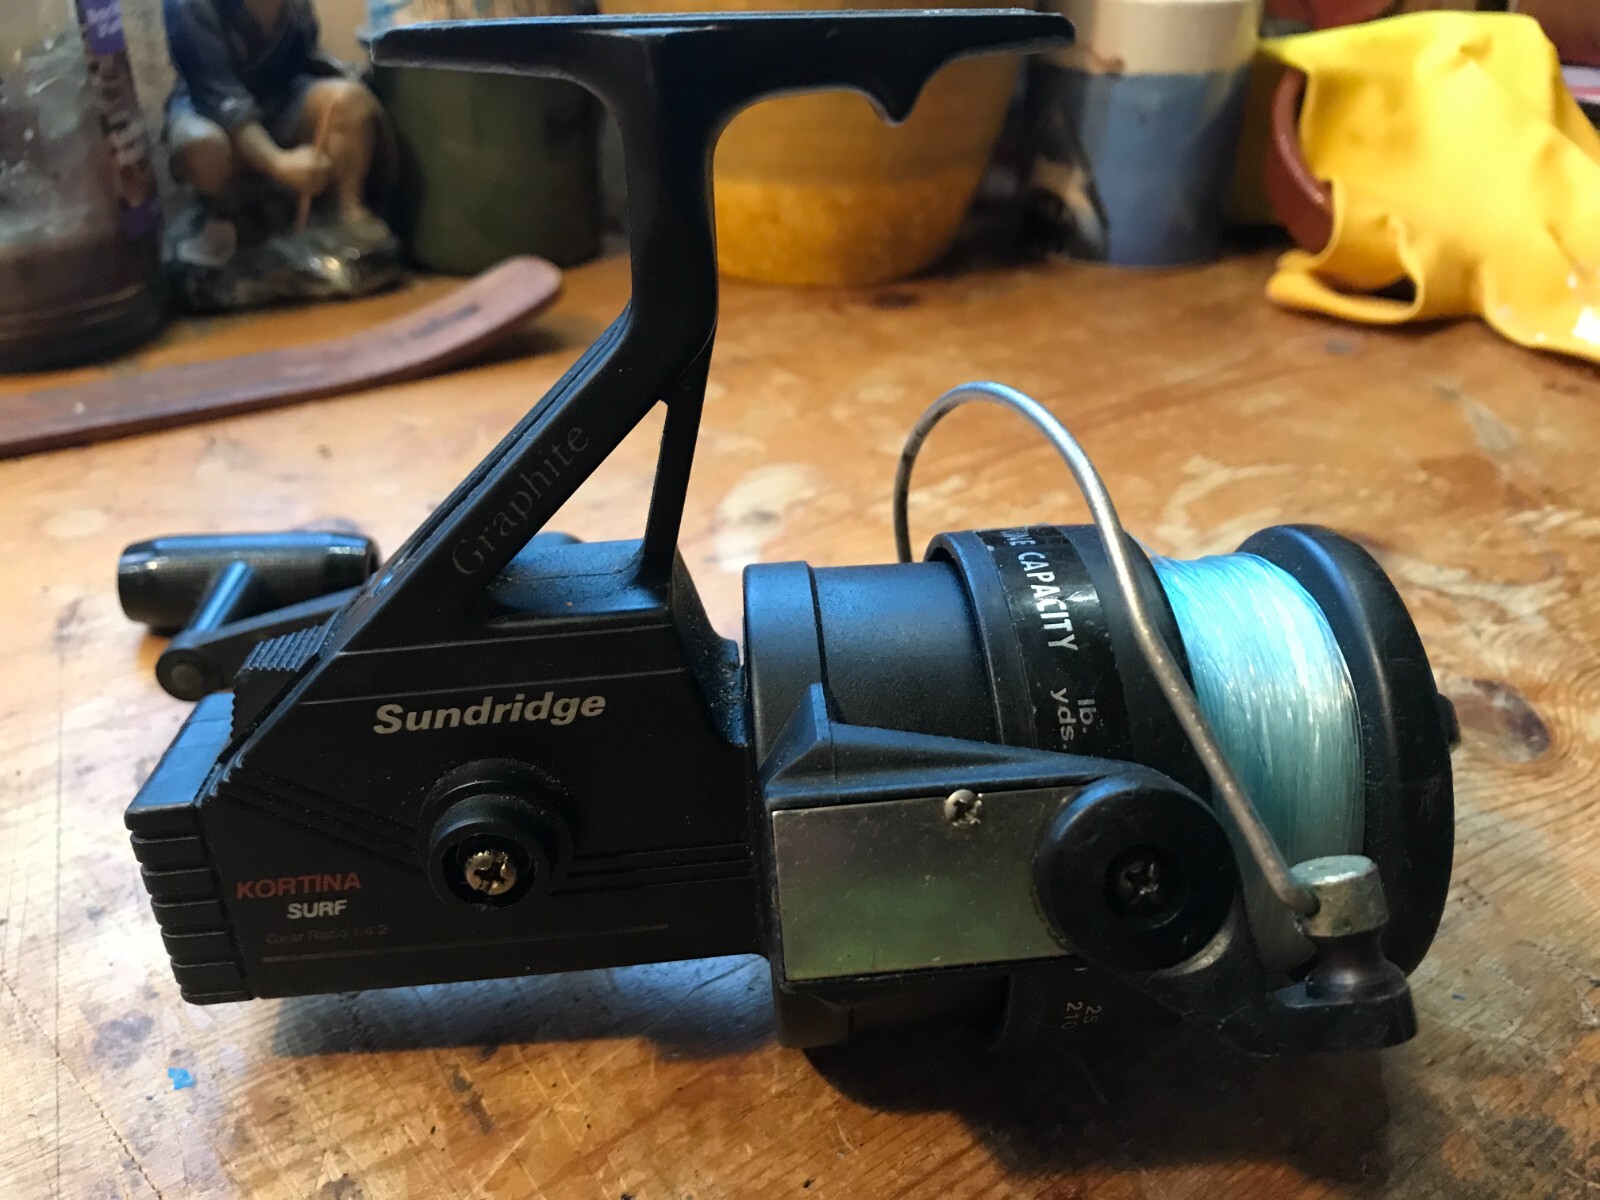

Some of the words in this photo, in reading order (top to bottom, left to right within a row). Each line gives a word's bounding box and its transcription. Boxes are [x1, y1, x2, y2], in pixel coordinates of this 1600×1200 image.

[452, 426, 590, 575] Graphite
[1018, 551, 1079, 651] CAPACITY
[373, 691, 606, 734] Sundridge
[1050, 687, 1077, 750] yds.
[1077, 698, 1097, 734] lb.
[236, 871, 363, 899] KORTINA
[286, 899, 349, 920] SURF
[265, 932, 305, 945] Gear
[308, 929, 350, 941] Ratio
[1060, 1000, 1084, 1030] 210
